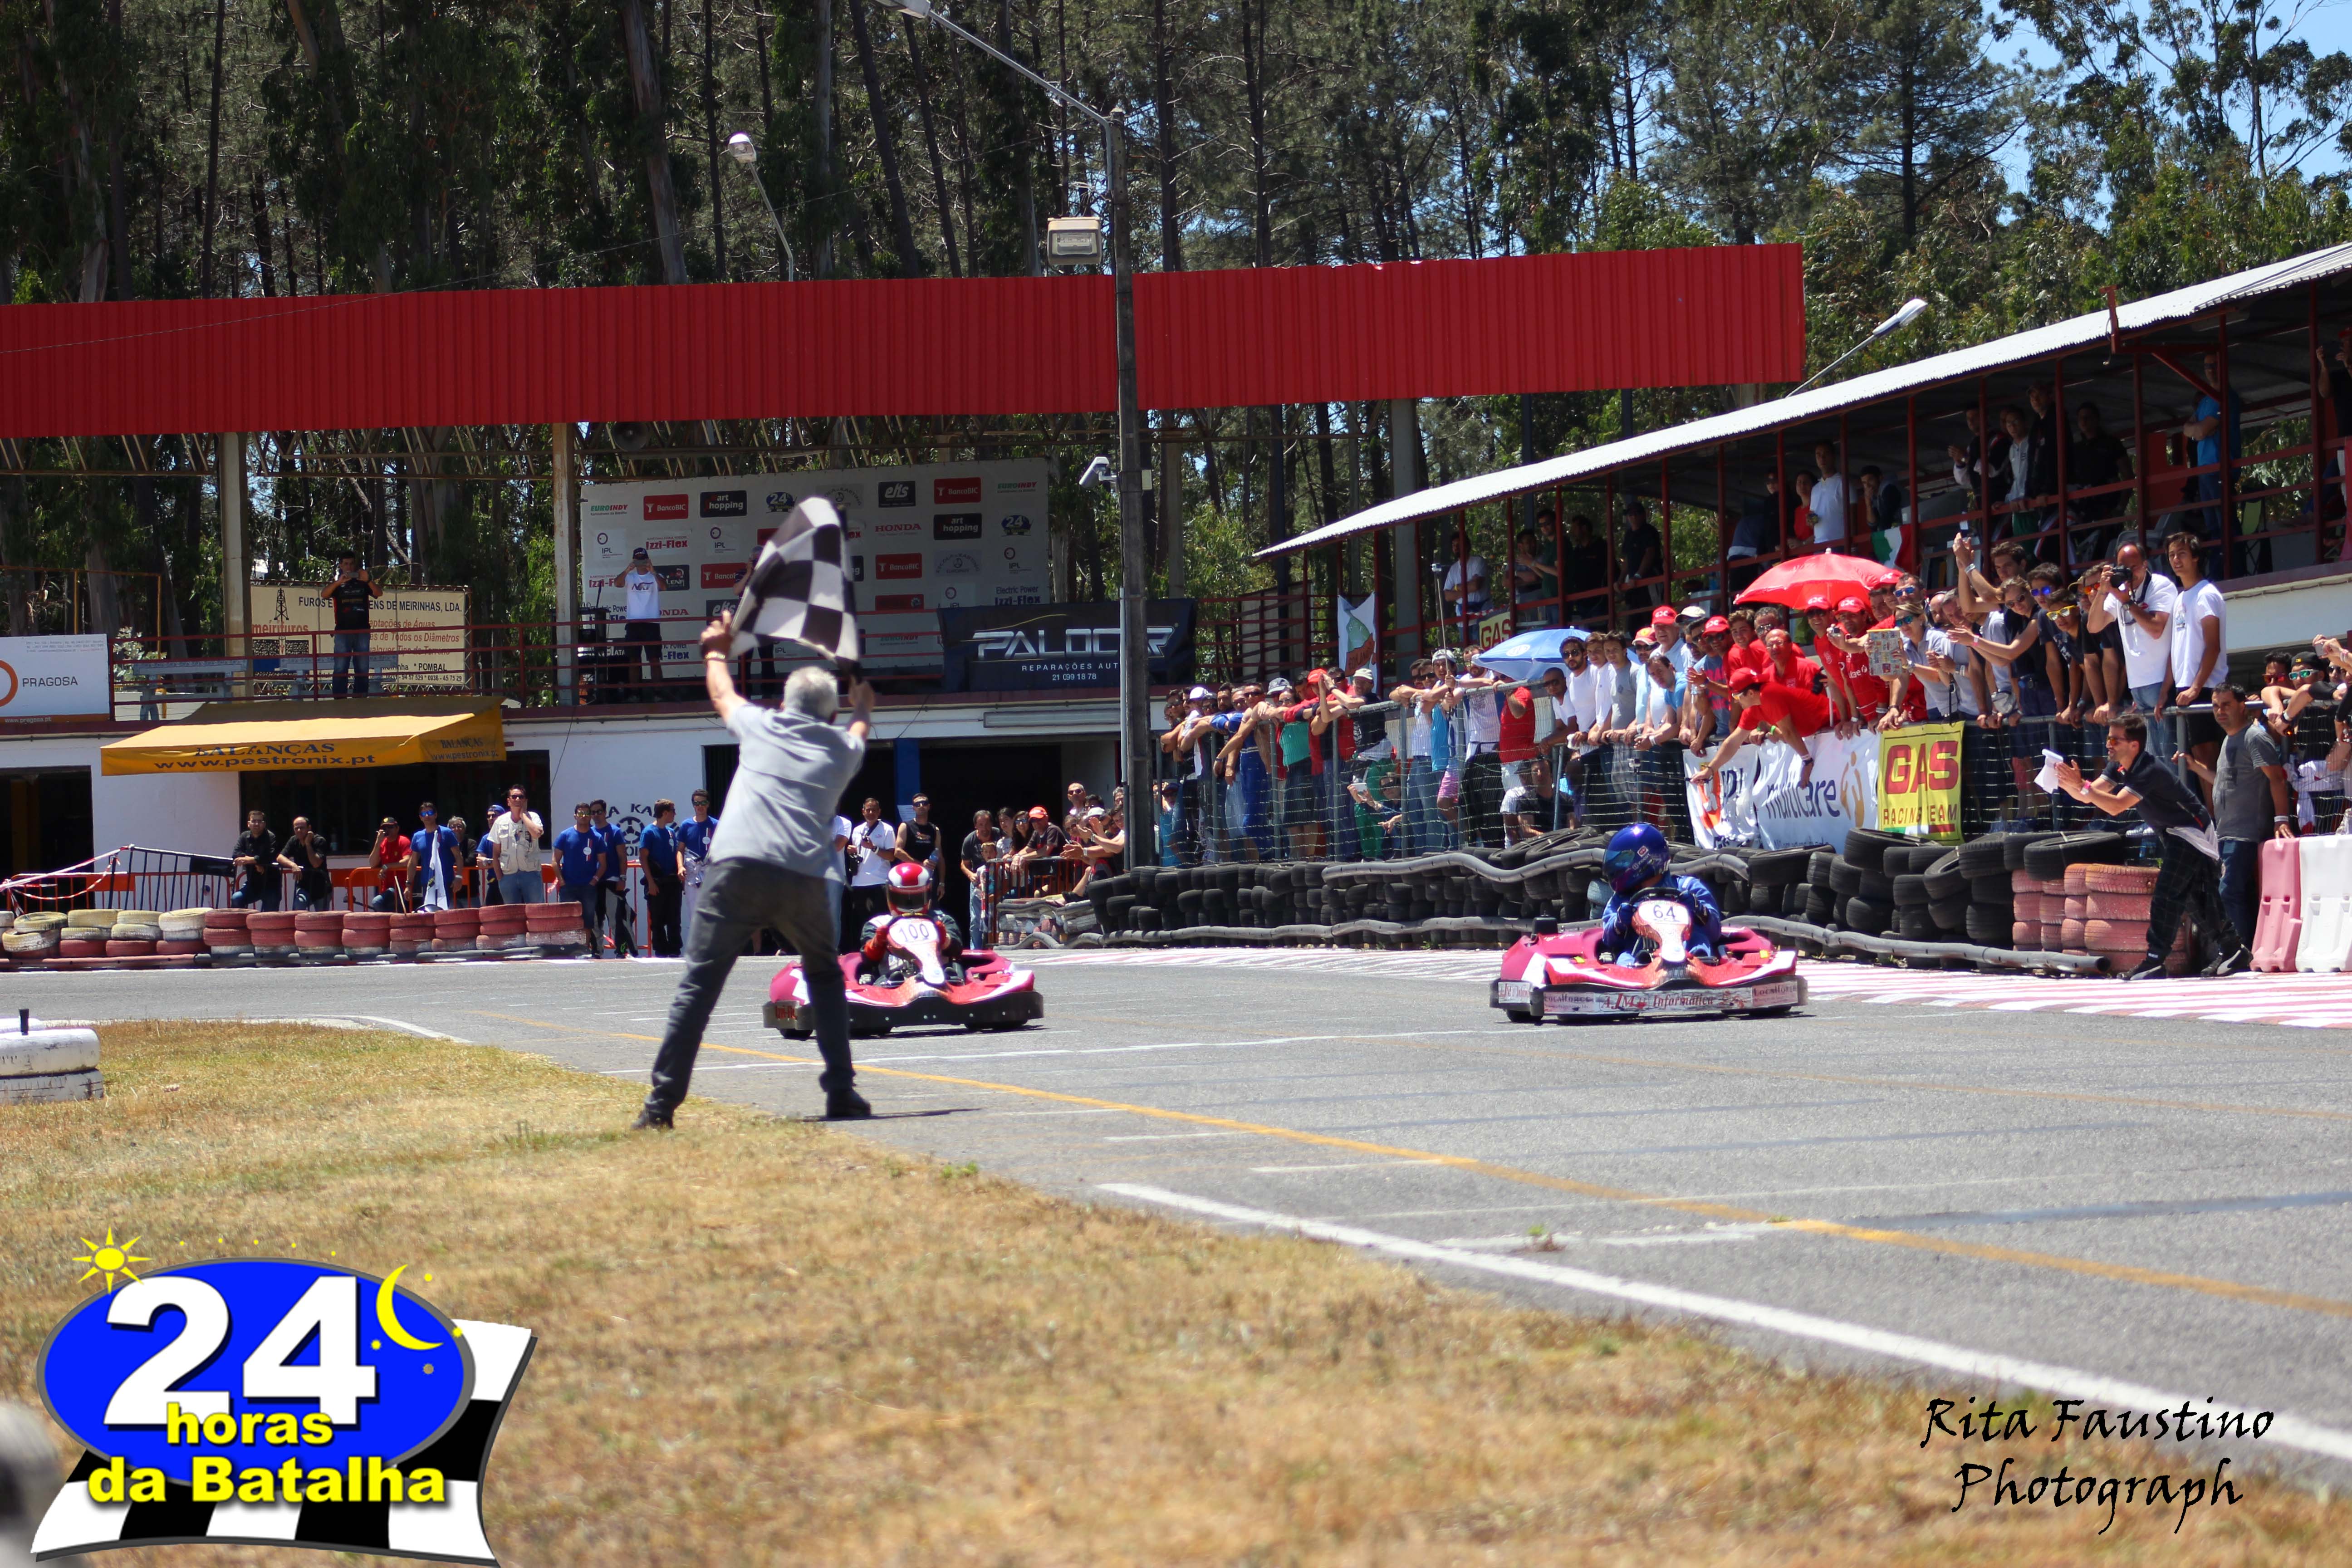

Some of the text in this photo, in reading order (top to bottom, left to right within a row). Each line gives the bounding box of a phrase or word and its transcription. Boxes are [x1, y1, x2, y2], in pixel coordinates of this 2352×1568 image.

[948, 487, 978, 495] BancoBIC
[770, 493, 788, 505] 24
[1005, 515, 1023, 527] 24
[875, 524, 922, 532] HONDA
[646, 540, 688, 550] Izzi-Flex
[996, 586, 1019, 594] Electric
[299, 597, 326, 608] FUROS
[387, 601, 397, 610] DE
[445, 602, 462, 612] LDA.
[369, 618, 401, 629] aptações
[403, 619, 412, 627] de
[380, 632, 388, 641] de
[392, 632, 412, 642] Todos
[424, 633, 459, 642] Diâmetros
[1481, 618, 1511, 650] GAS
[972, 626, 1175, 661] PALOCR
[418, 663, 447, 671] POMBAL
[1021, 662, 1092, 671] REPARAÇÕES
[22, 676, 78, 687] PRAGOSA
[154, 754, 376, 769] www.pestronix.pt
[1884, 740, 1959, 794] GAS
[1883, 806, 1922, 825] RACING
[1653, 905, 1676, 920] 64
[899, 923, 930, 942] 100
